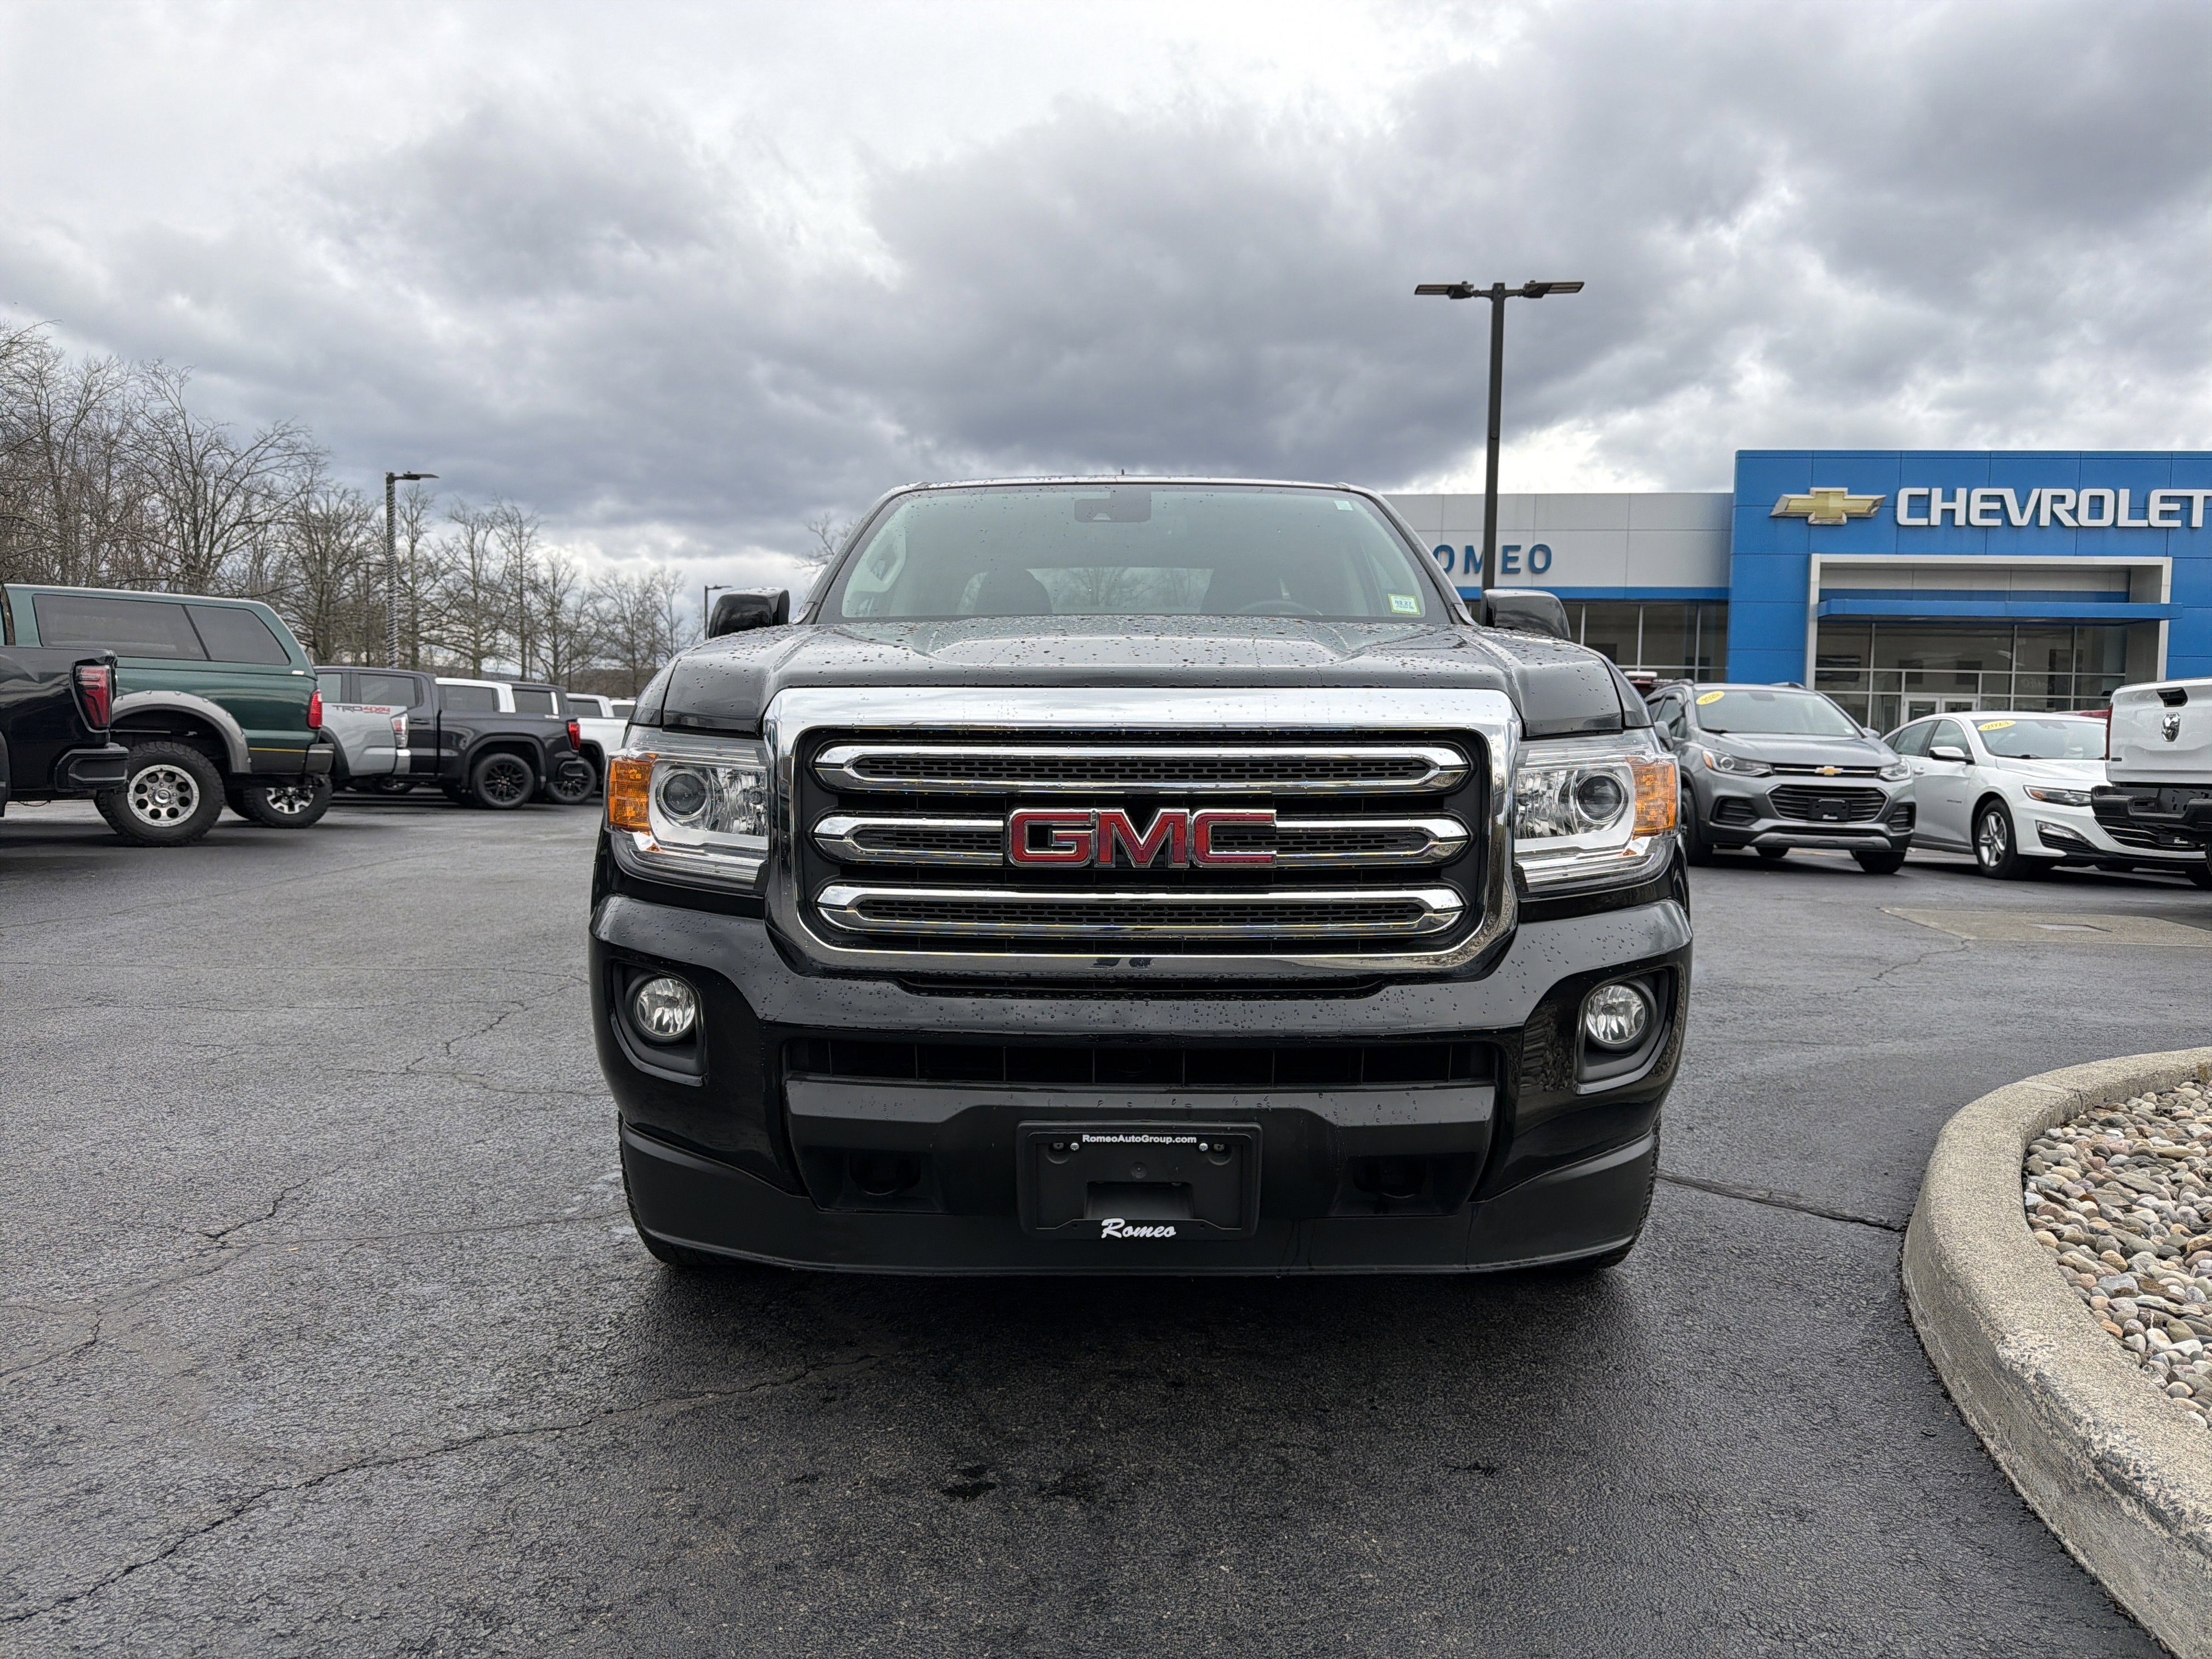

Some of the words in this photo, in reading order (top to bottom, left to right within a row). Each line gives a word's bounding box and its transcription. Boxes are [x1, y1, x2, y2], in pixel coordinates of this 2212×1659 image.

[1897, 488, 2212, 527] CHEVROLET
[1007, 808, 1277, 868] GMC
[1082, 1134, 1197, 1144] RomeoAutoGroup.com
[1101, 1217, 1177, 1239] Romeo
